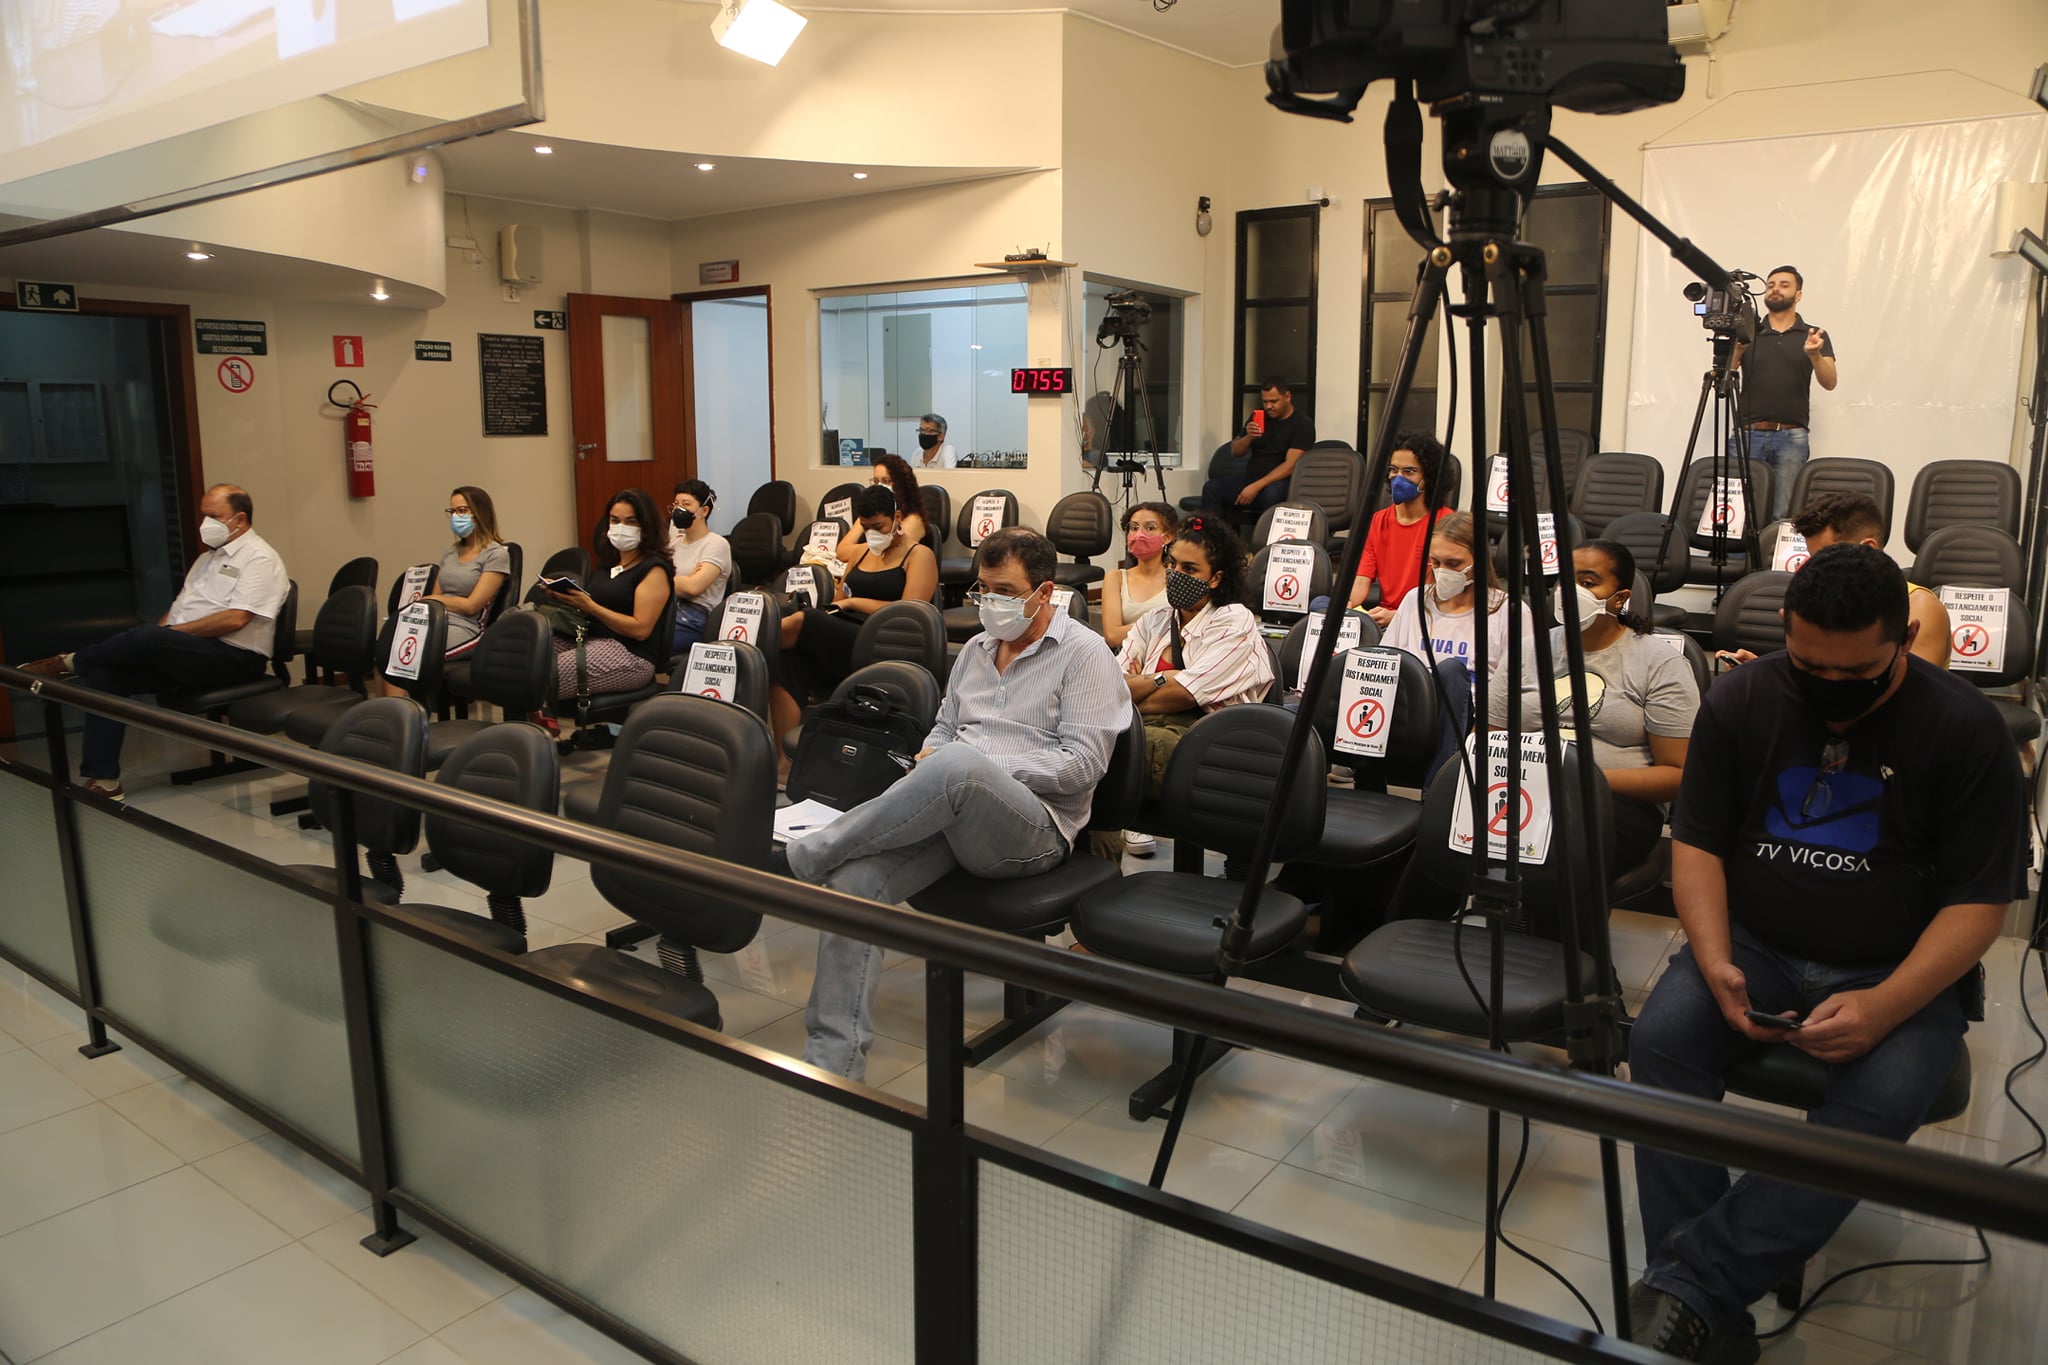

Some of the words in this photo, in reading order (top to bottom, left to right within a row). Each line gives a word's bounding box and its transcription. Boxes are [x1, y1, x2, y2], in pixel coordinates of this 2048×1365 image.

[1954, 592, 1985, 601] RESPEITE
[1960, 614, 1984, 623] SOCIAL
[1458, 641, 1468, 655] O
[704, 650, 728, 660] RESPEITE
[1357, 657, 1389, 671] RESPEITE
[1391, 662, 1396, 671] O
[704, 676, 722, 687] SOCIAL
[1359, 686, 1383, 698] SOCIAL
[1756, 843, 1782, 860] TV
[1789, 845, 1871, 872] VIÇOSA
